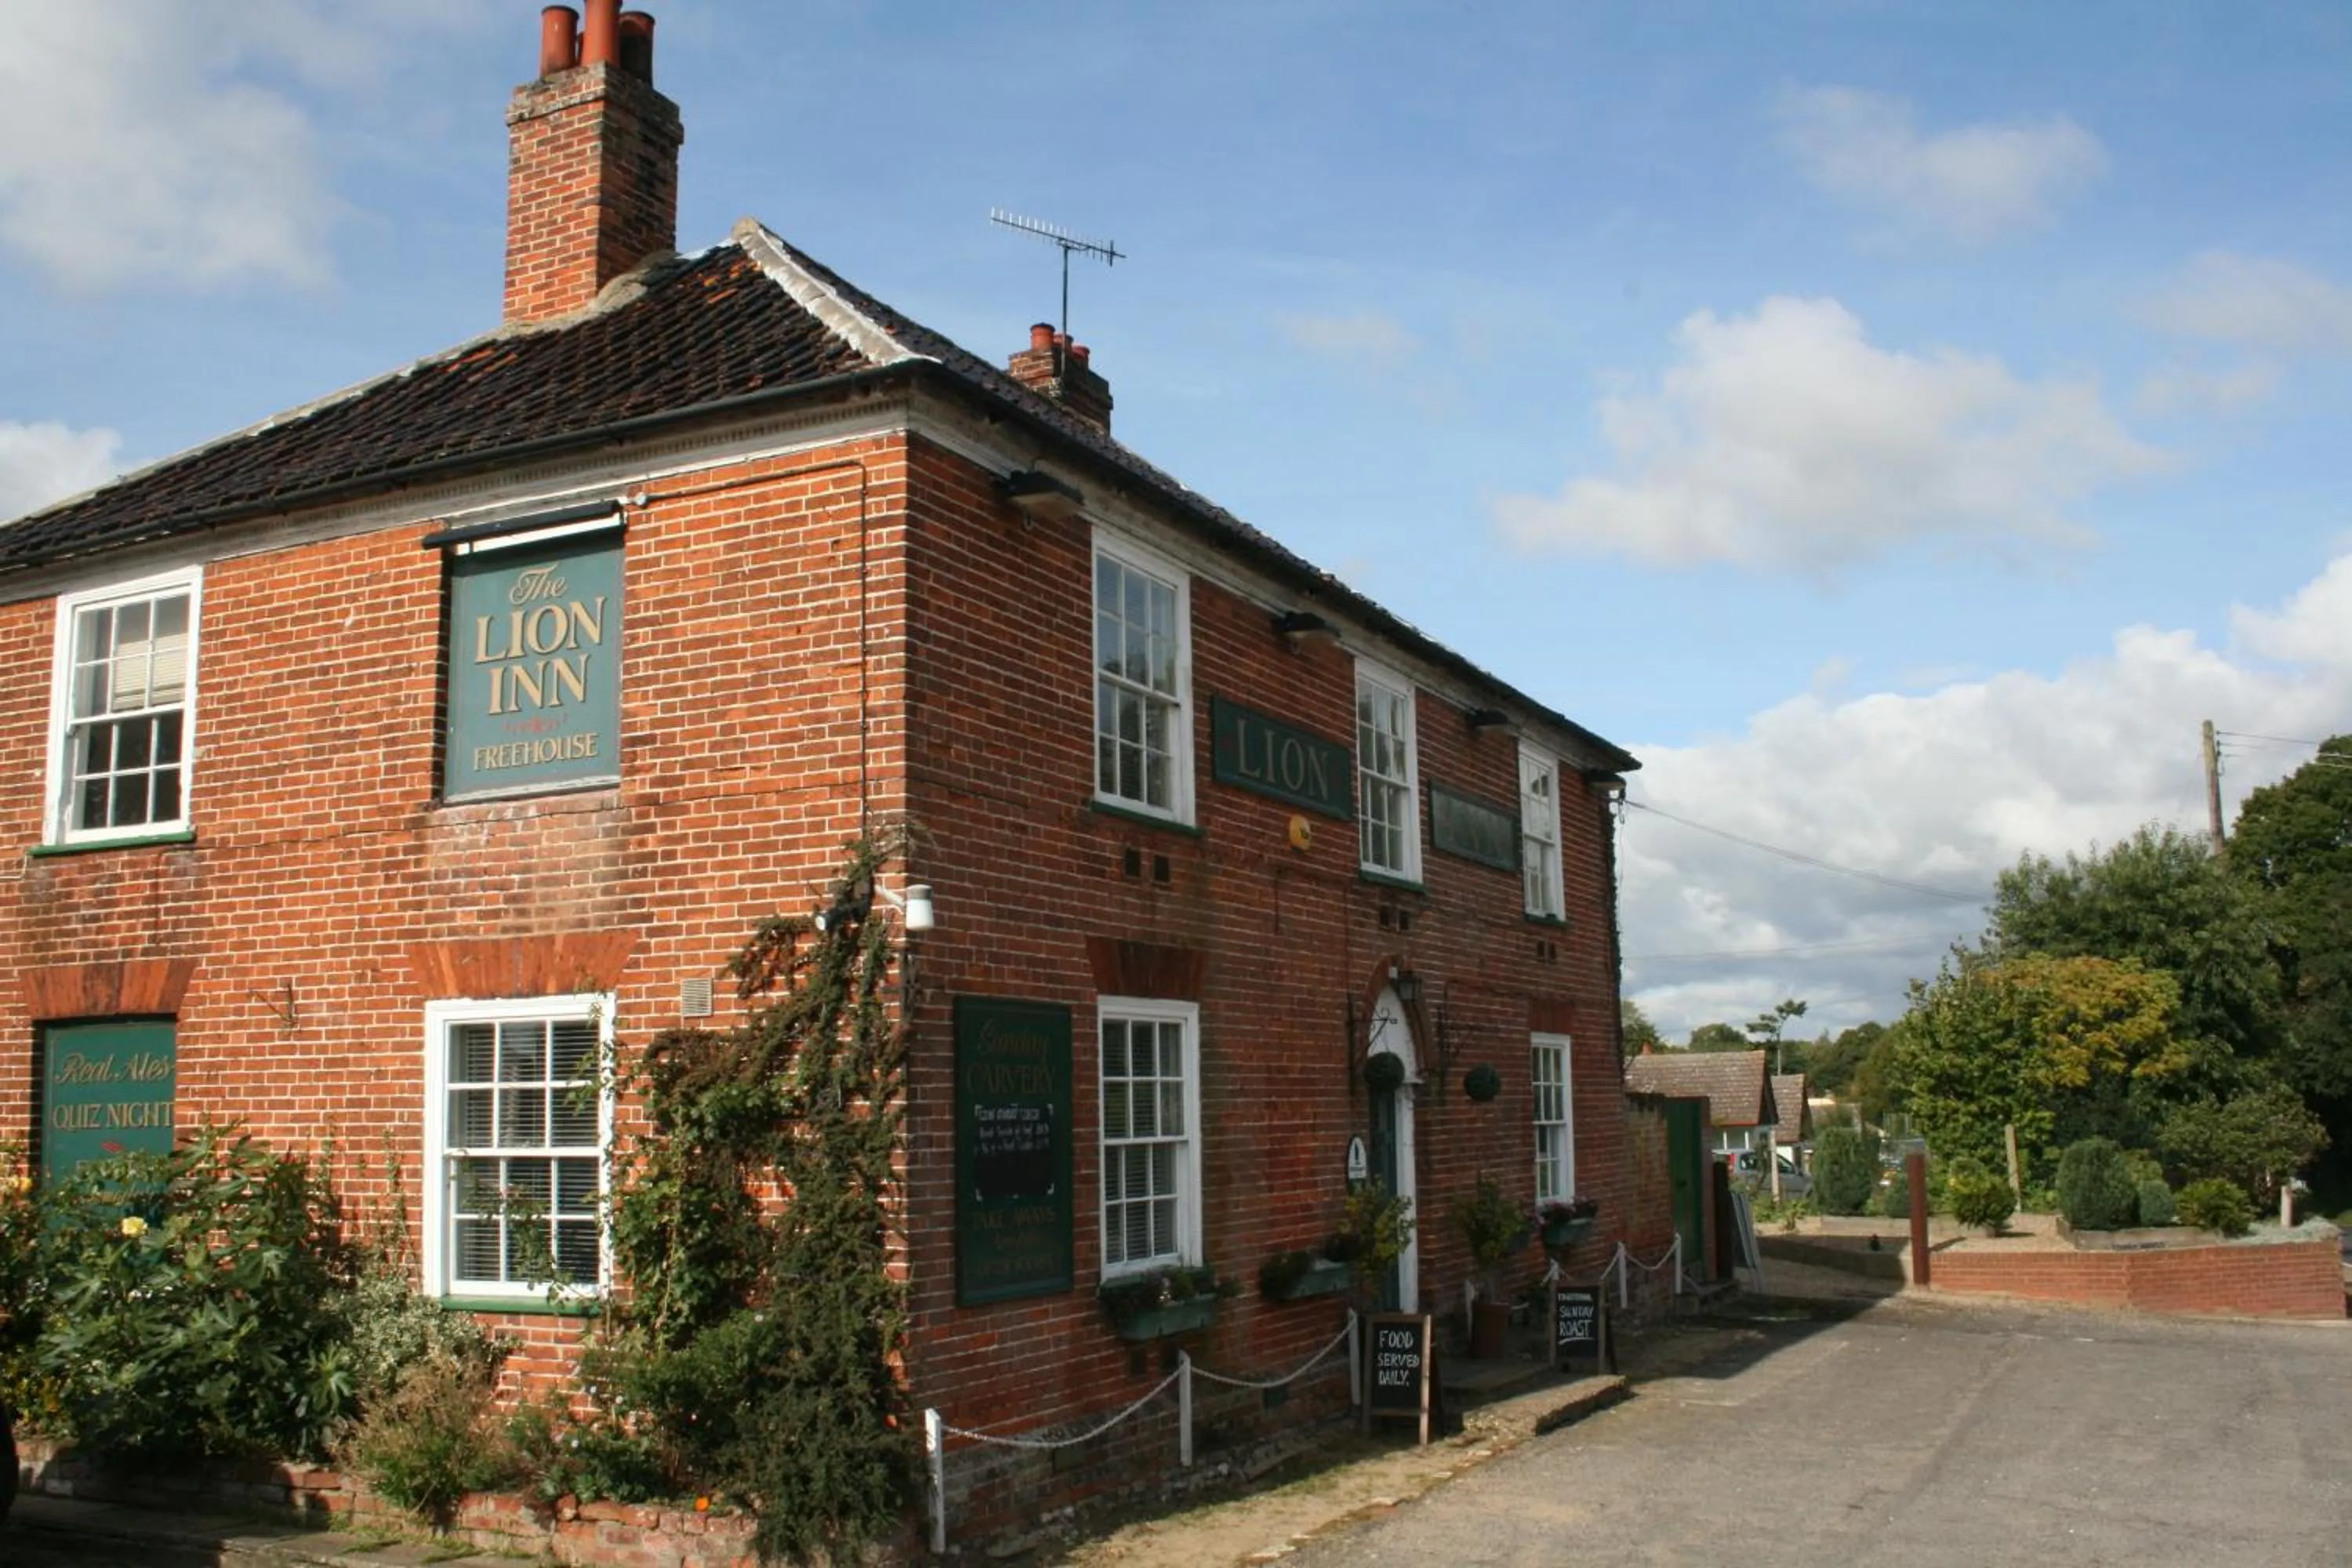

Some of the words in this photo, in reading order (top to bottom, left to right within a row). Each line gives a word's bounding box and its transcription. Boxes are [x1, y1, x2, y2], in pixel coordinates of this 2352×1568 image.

[510, 562, 567, 604] The
[474, 596, 607, 664] LION
[488, 653, 590, 714] INN
[473, 732, 600, 771] FREEHOUSE
[1236, 718, 1329, 801] LION
[54, 1052, 114, 1084] Real
[116, 1051, 175, 1082] Ales
[966, 1053, 1056, 1095] CARVERY
[53, 1103, 101, 1131] QUIZ
[106, 1101, 175, 1129] NIGHT
[1559, 1305, 1594, 1319] SUNDAY
[1559, 1319, 1593, 1338] ROAST
[1379, 1330, 1414, 1349] FOOD
[1377, 1352, 1420, 1368] SERVED
